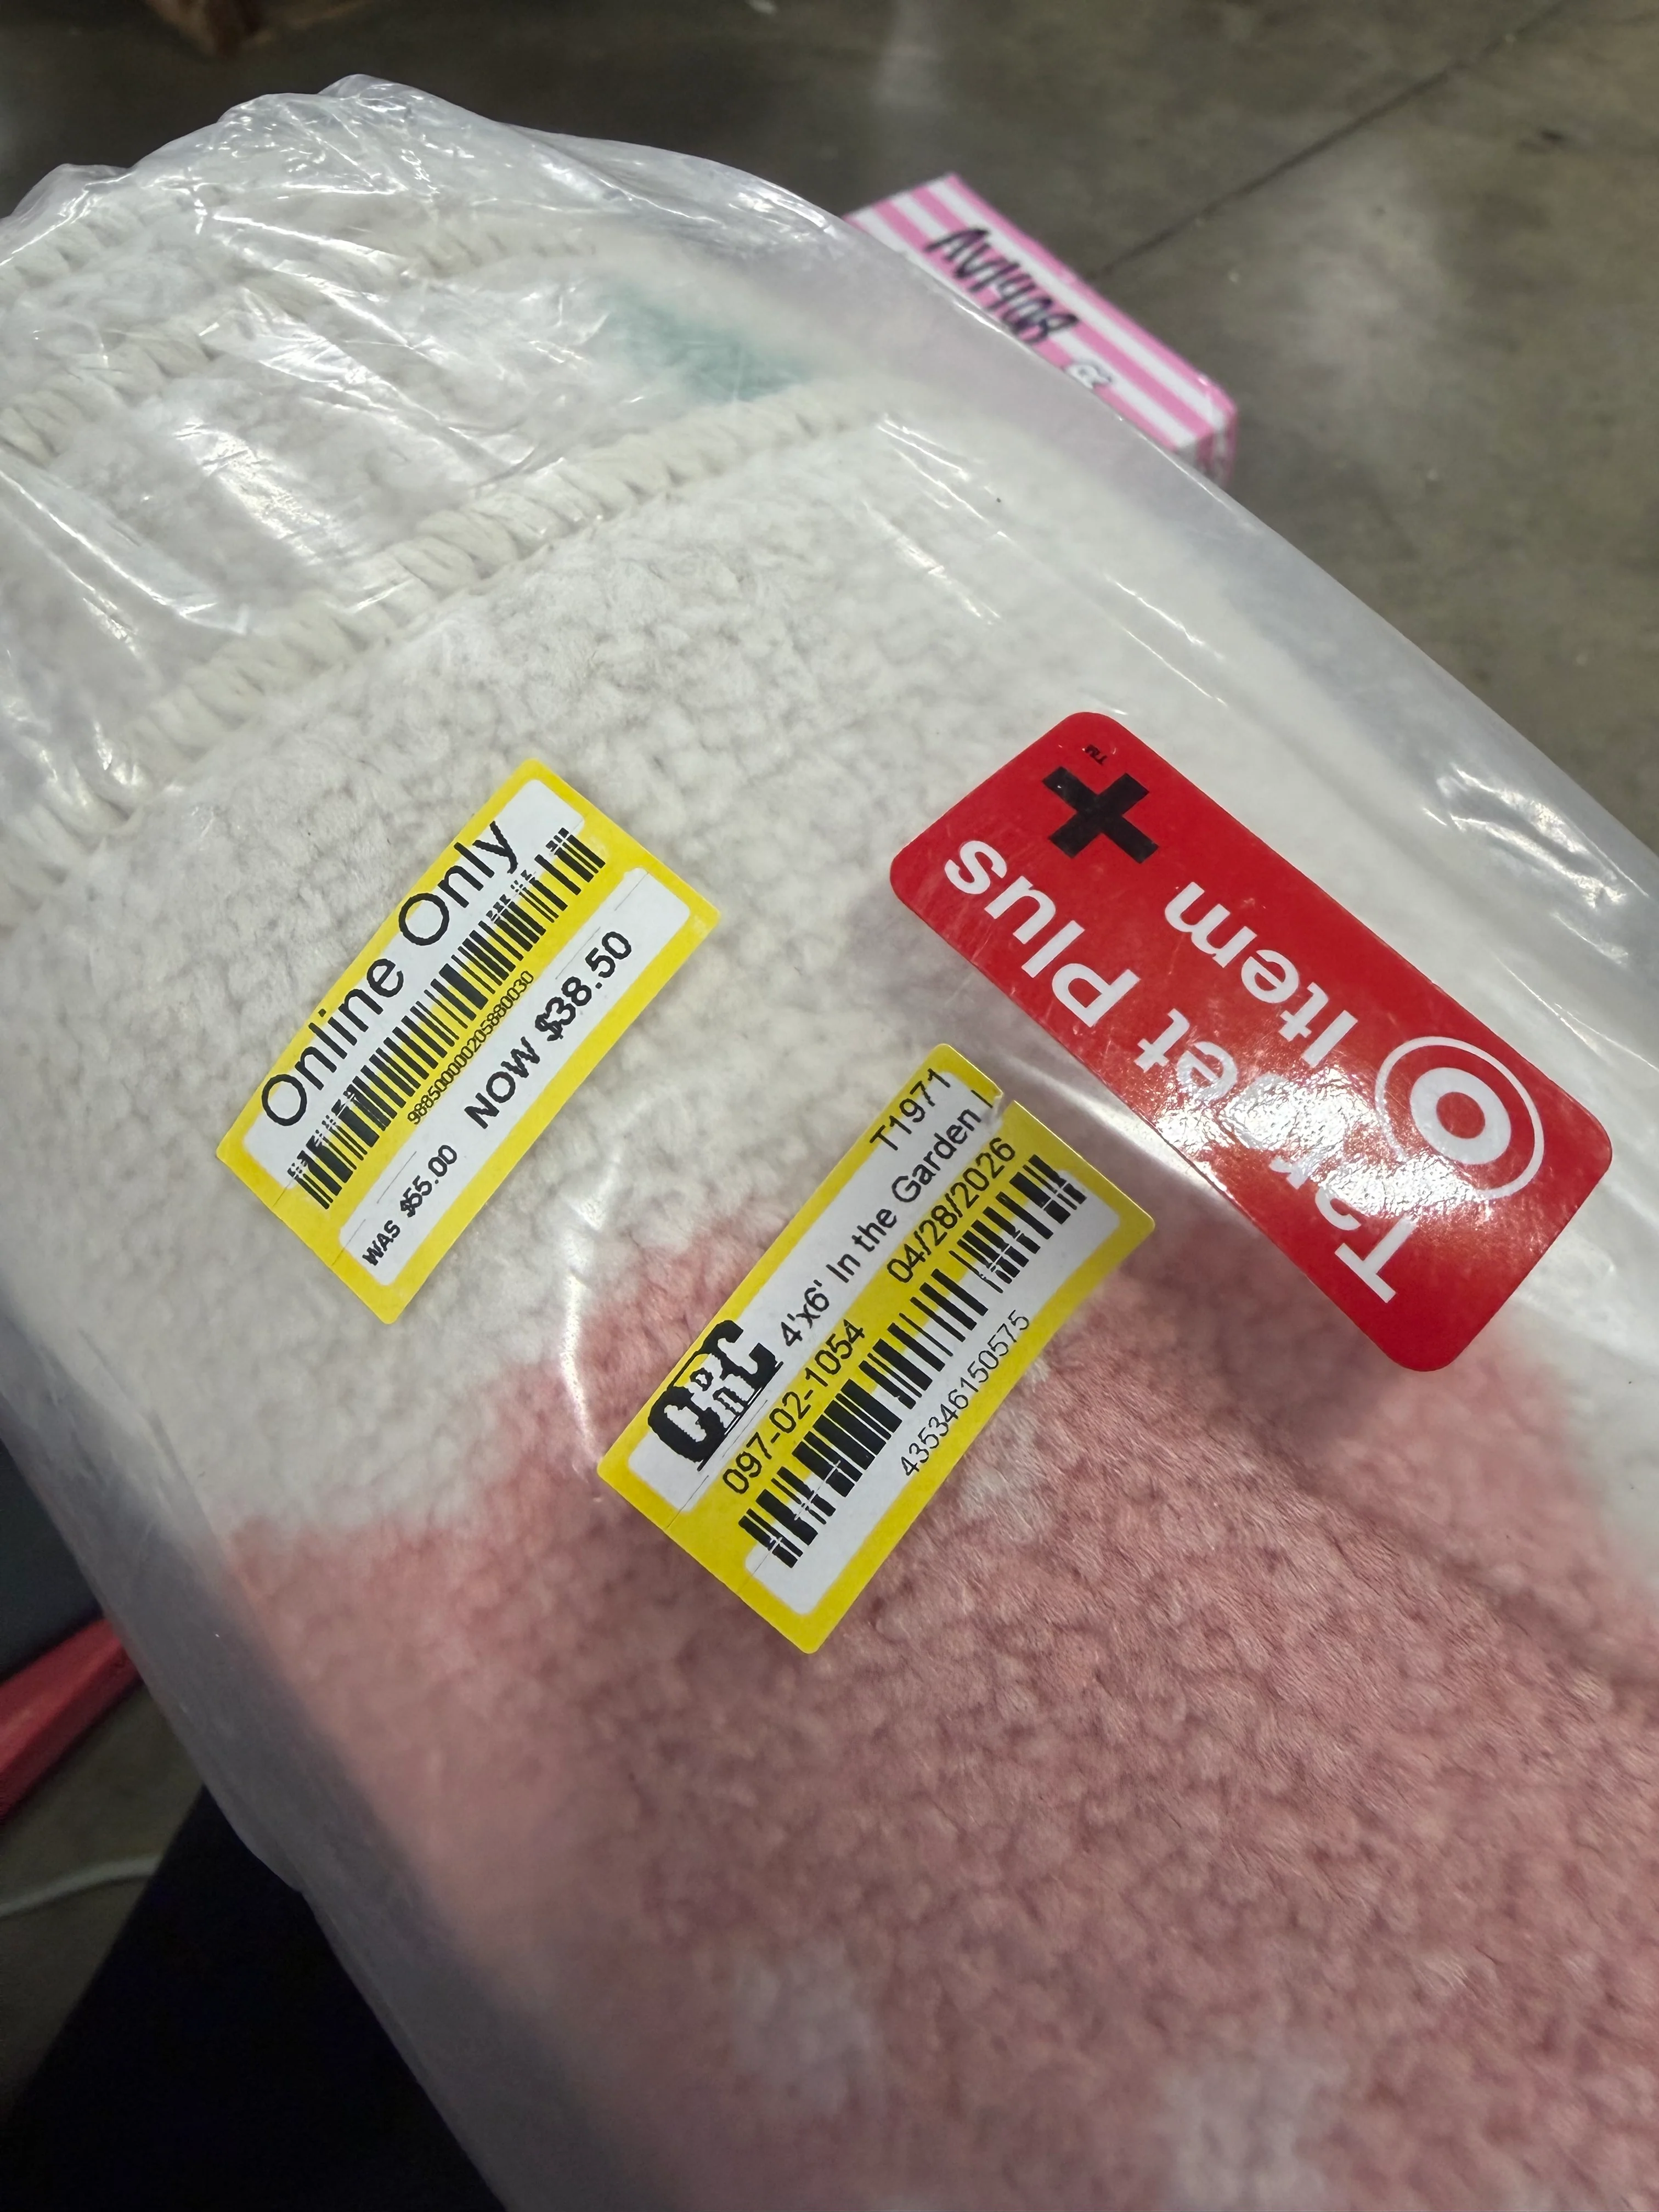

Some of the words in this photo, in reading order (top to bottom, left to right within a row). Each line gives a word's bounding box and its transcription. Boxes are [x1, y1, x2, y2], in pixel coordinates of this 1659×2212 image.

[261, 958, 404, 1127] Online
[398, 820, 519, 947] Only
[944, 839, 1141, 1028] Plus
[1164, 881, 1359, 1077] Item
[362, 1220, 401, 1267] WAS
[399, 1144, 458, 1218] $55.00
[464, 1036, 541, 1130] NOW
[534, 930, 633, 1042] $38.50
[407, 970, 534, 1125] 988500000205880030
[868, 1067, 951, 1152] T1971
[722, 1318, 866, 1495] 097-02-1054
[886, 1136, 1016, 1284] 04/28/2026
[780, 1279, 830, 1347] 4'x6'
[825, 1253, 861, 1284] In
[851, 1208, 898, 1253] the
[891, 1108, 983, 1204] Garden
[900, 1308, 1030, 1477] 435346150575
